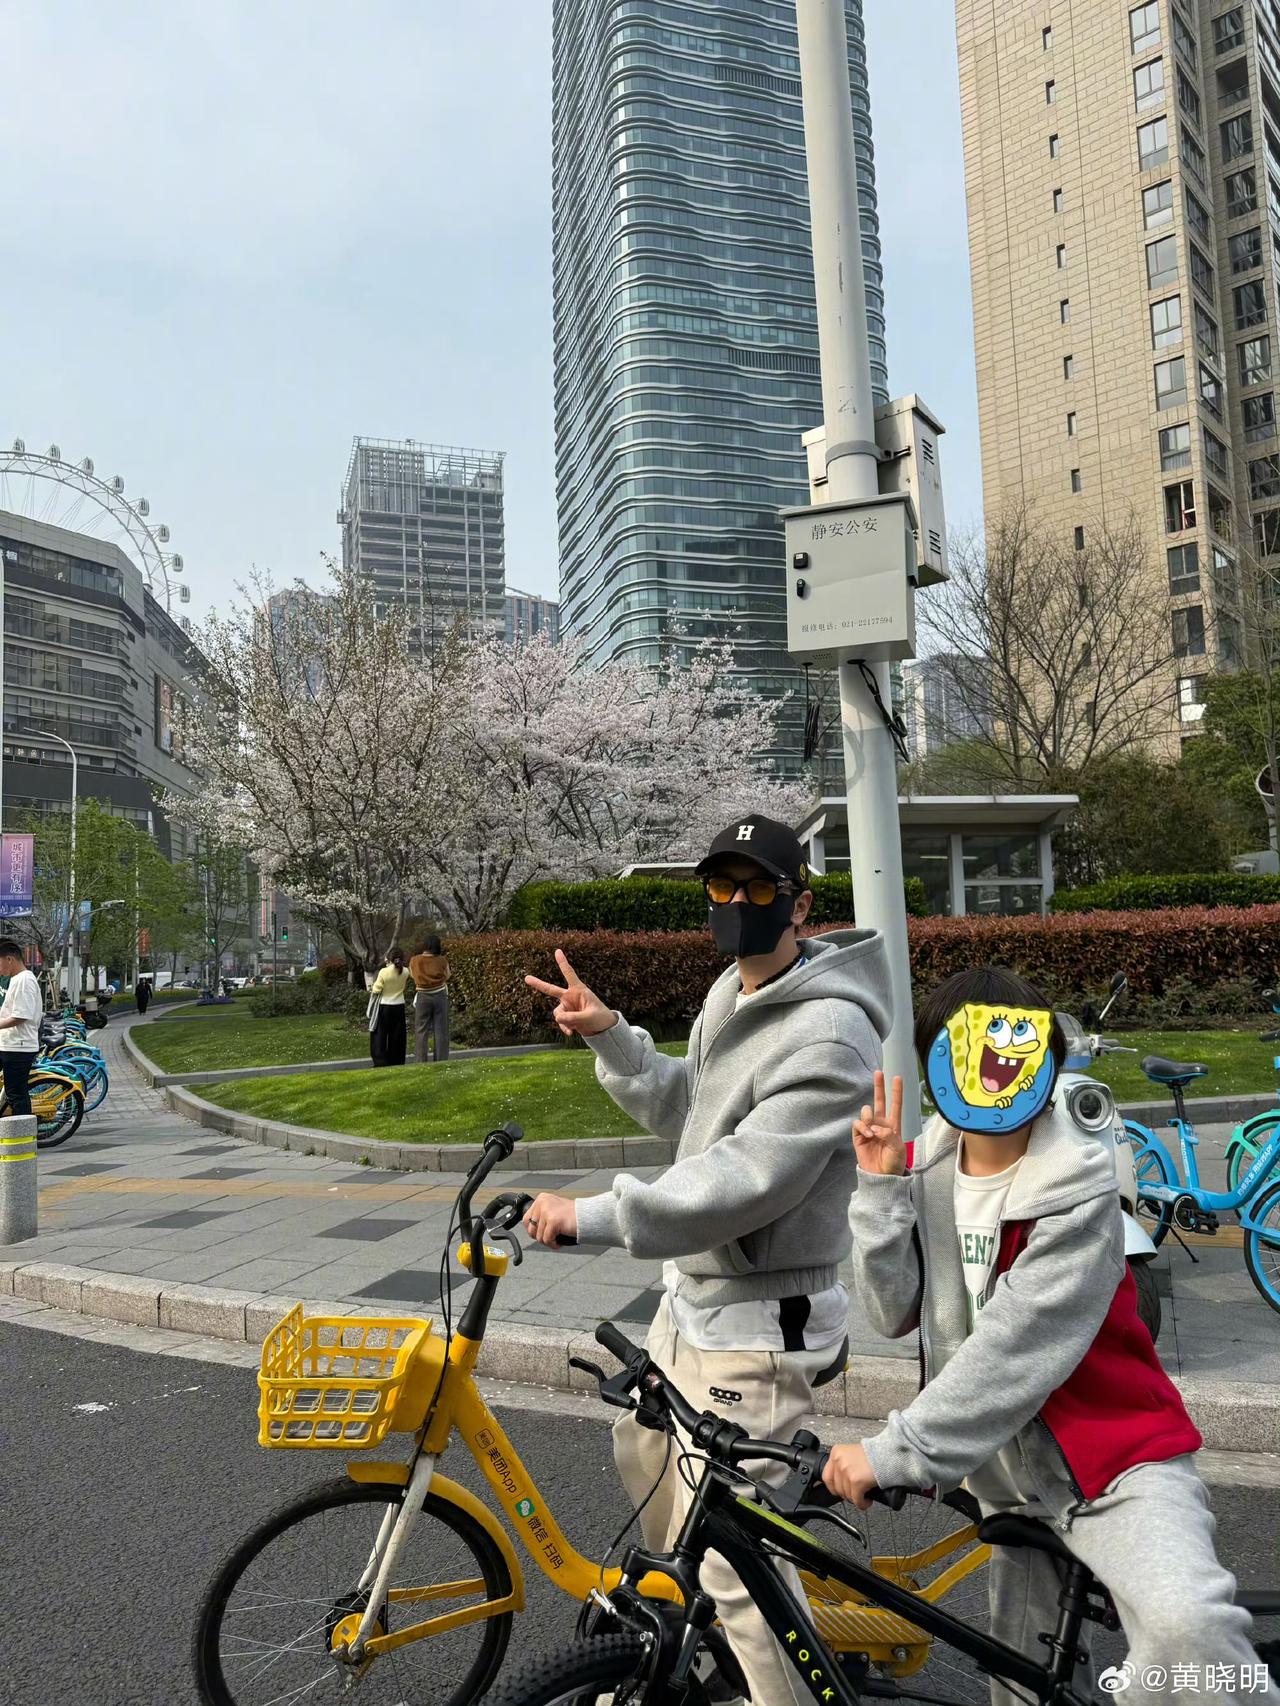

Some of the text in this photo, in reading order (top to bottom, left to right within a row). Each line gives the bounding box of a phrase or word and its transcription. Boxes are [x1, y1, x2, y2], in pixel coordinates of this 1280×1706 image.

[811, 516, 878, 541] 静安公安
[736, 825, 755, 840] H
[486, 1446, 564, 1570] 美团App 微信 扫码
[786, 1630, 834, 1701] ROCK
